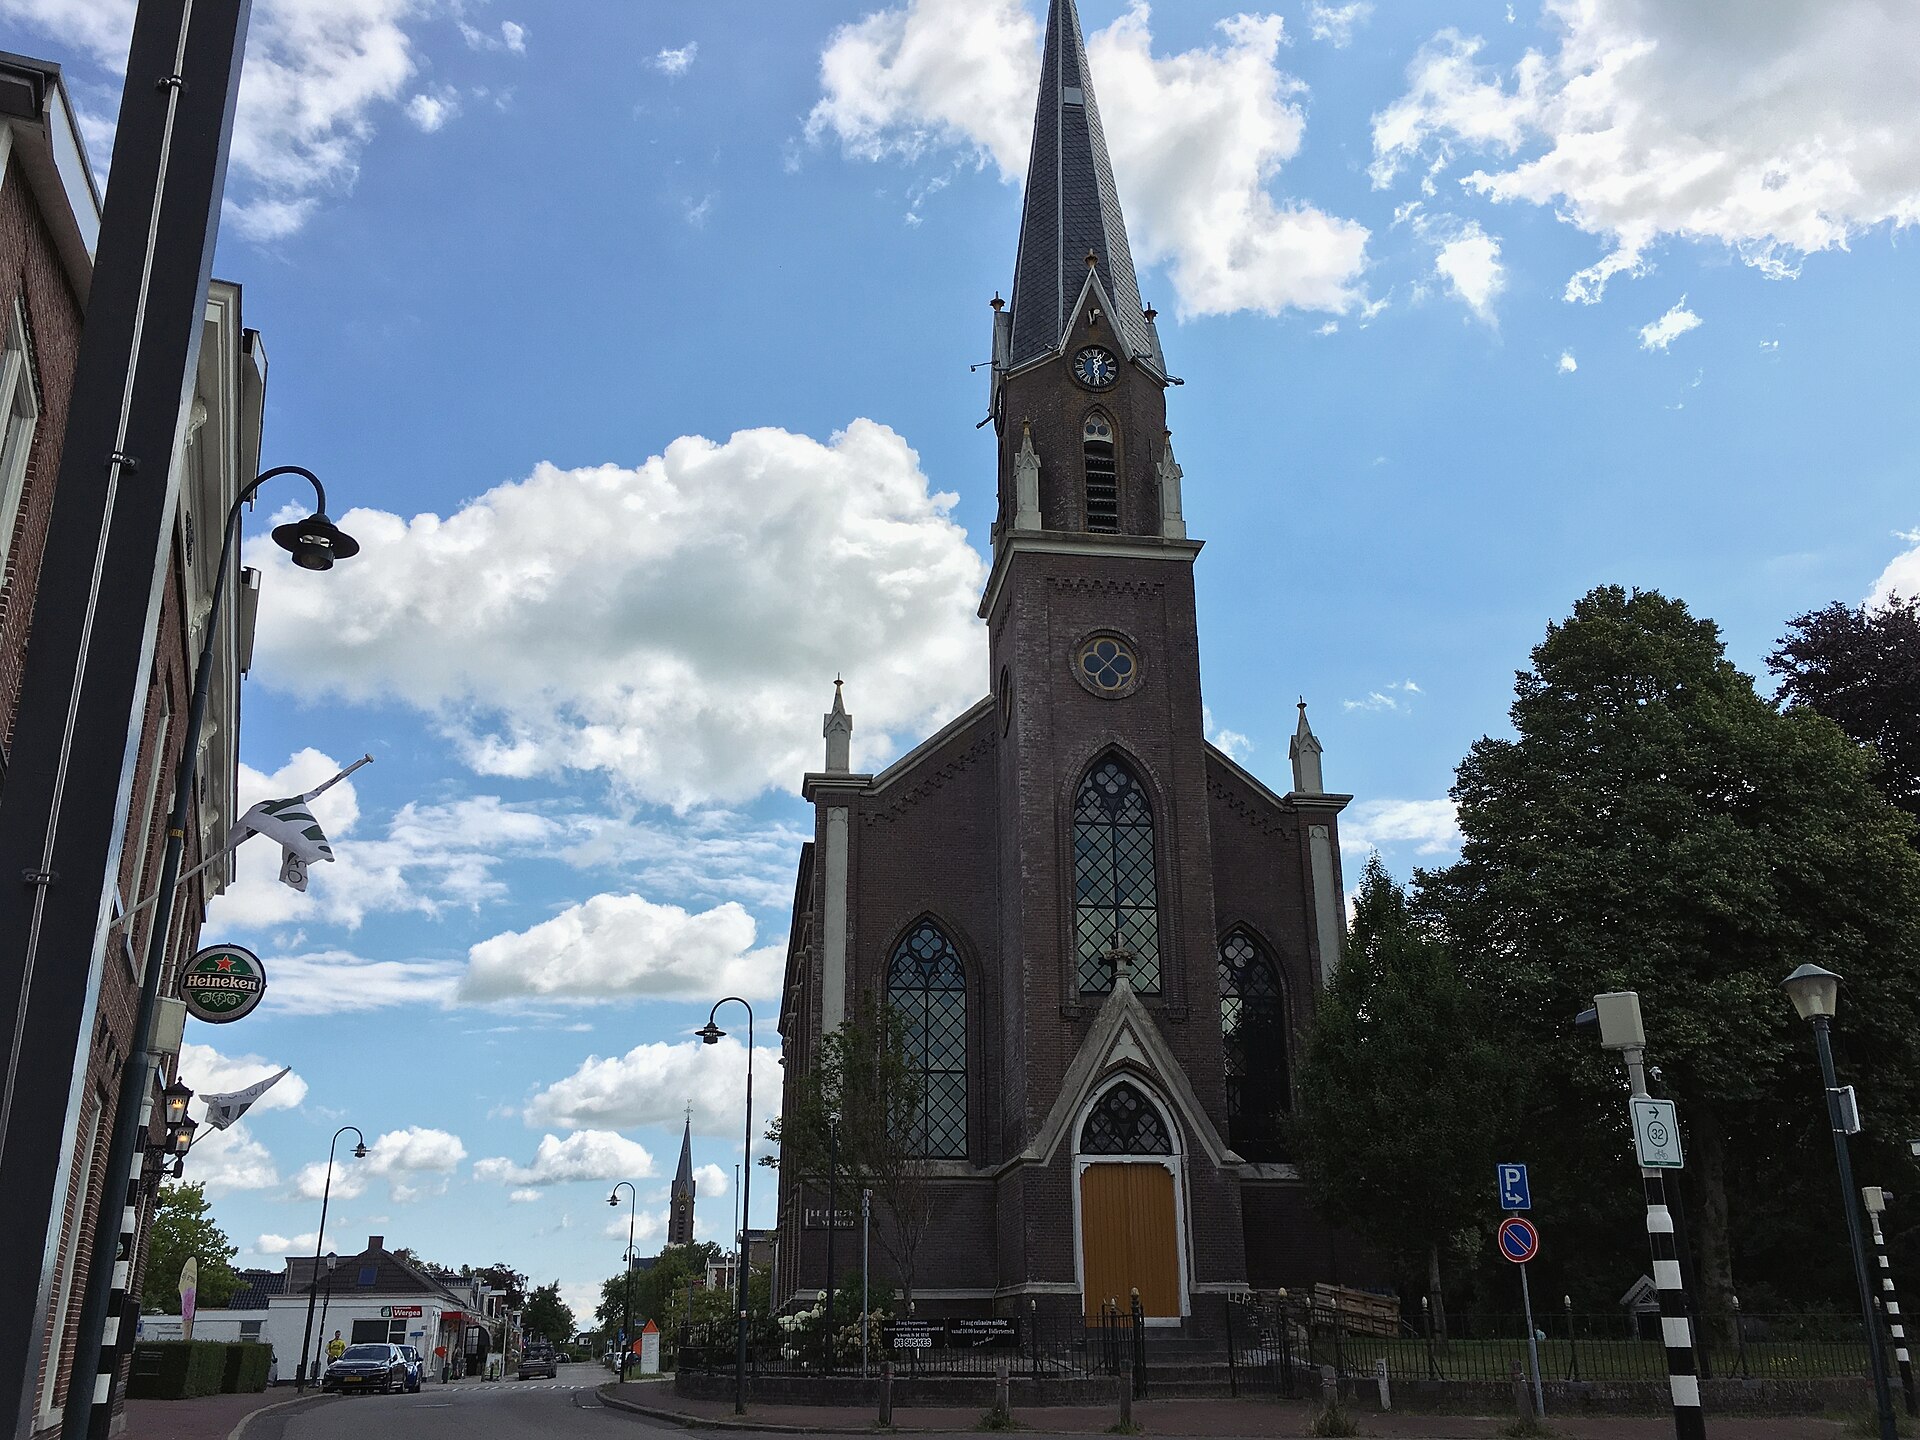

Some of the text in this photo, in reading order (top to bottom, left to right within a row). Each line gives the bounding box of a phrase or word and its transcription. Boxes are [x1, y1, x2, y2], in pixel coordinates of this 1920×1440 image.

[186, 974, 257, 990] Heineken
[1651, 1128, 1664, 1140] 32
[1504, 1168, 1521, 1191] P
[894, 1337, 932, 1348] DE SUSKES
